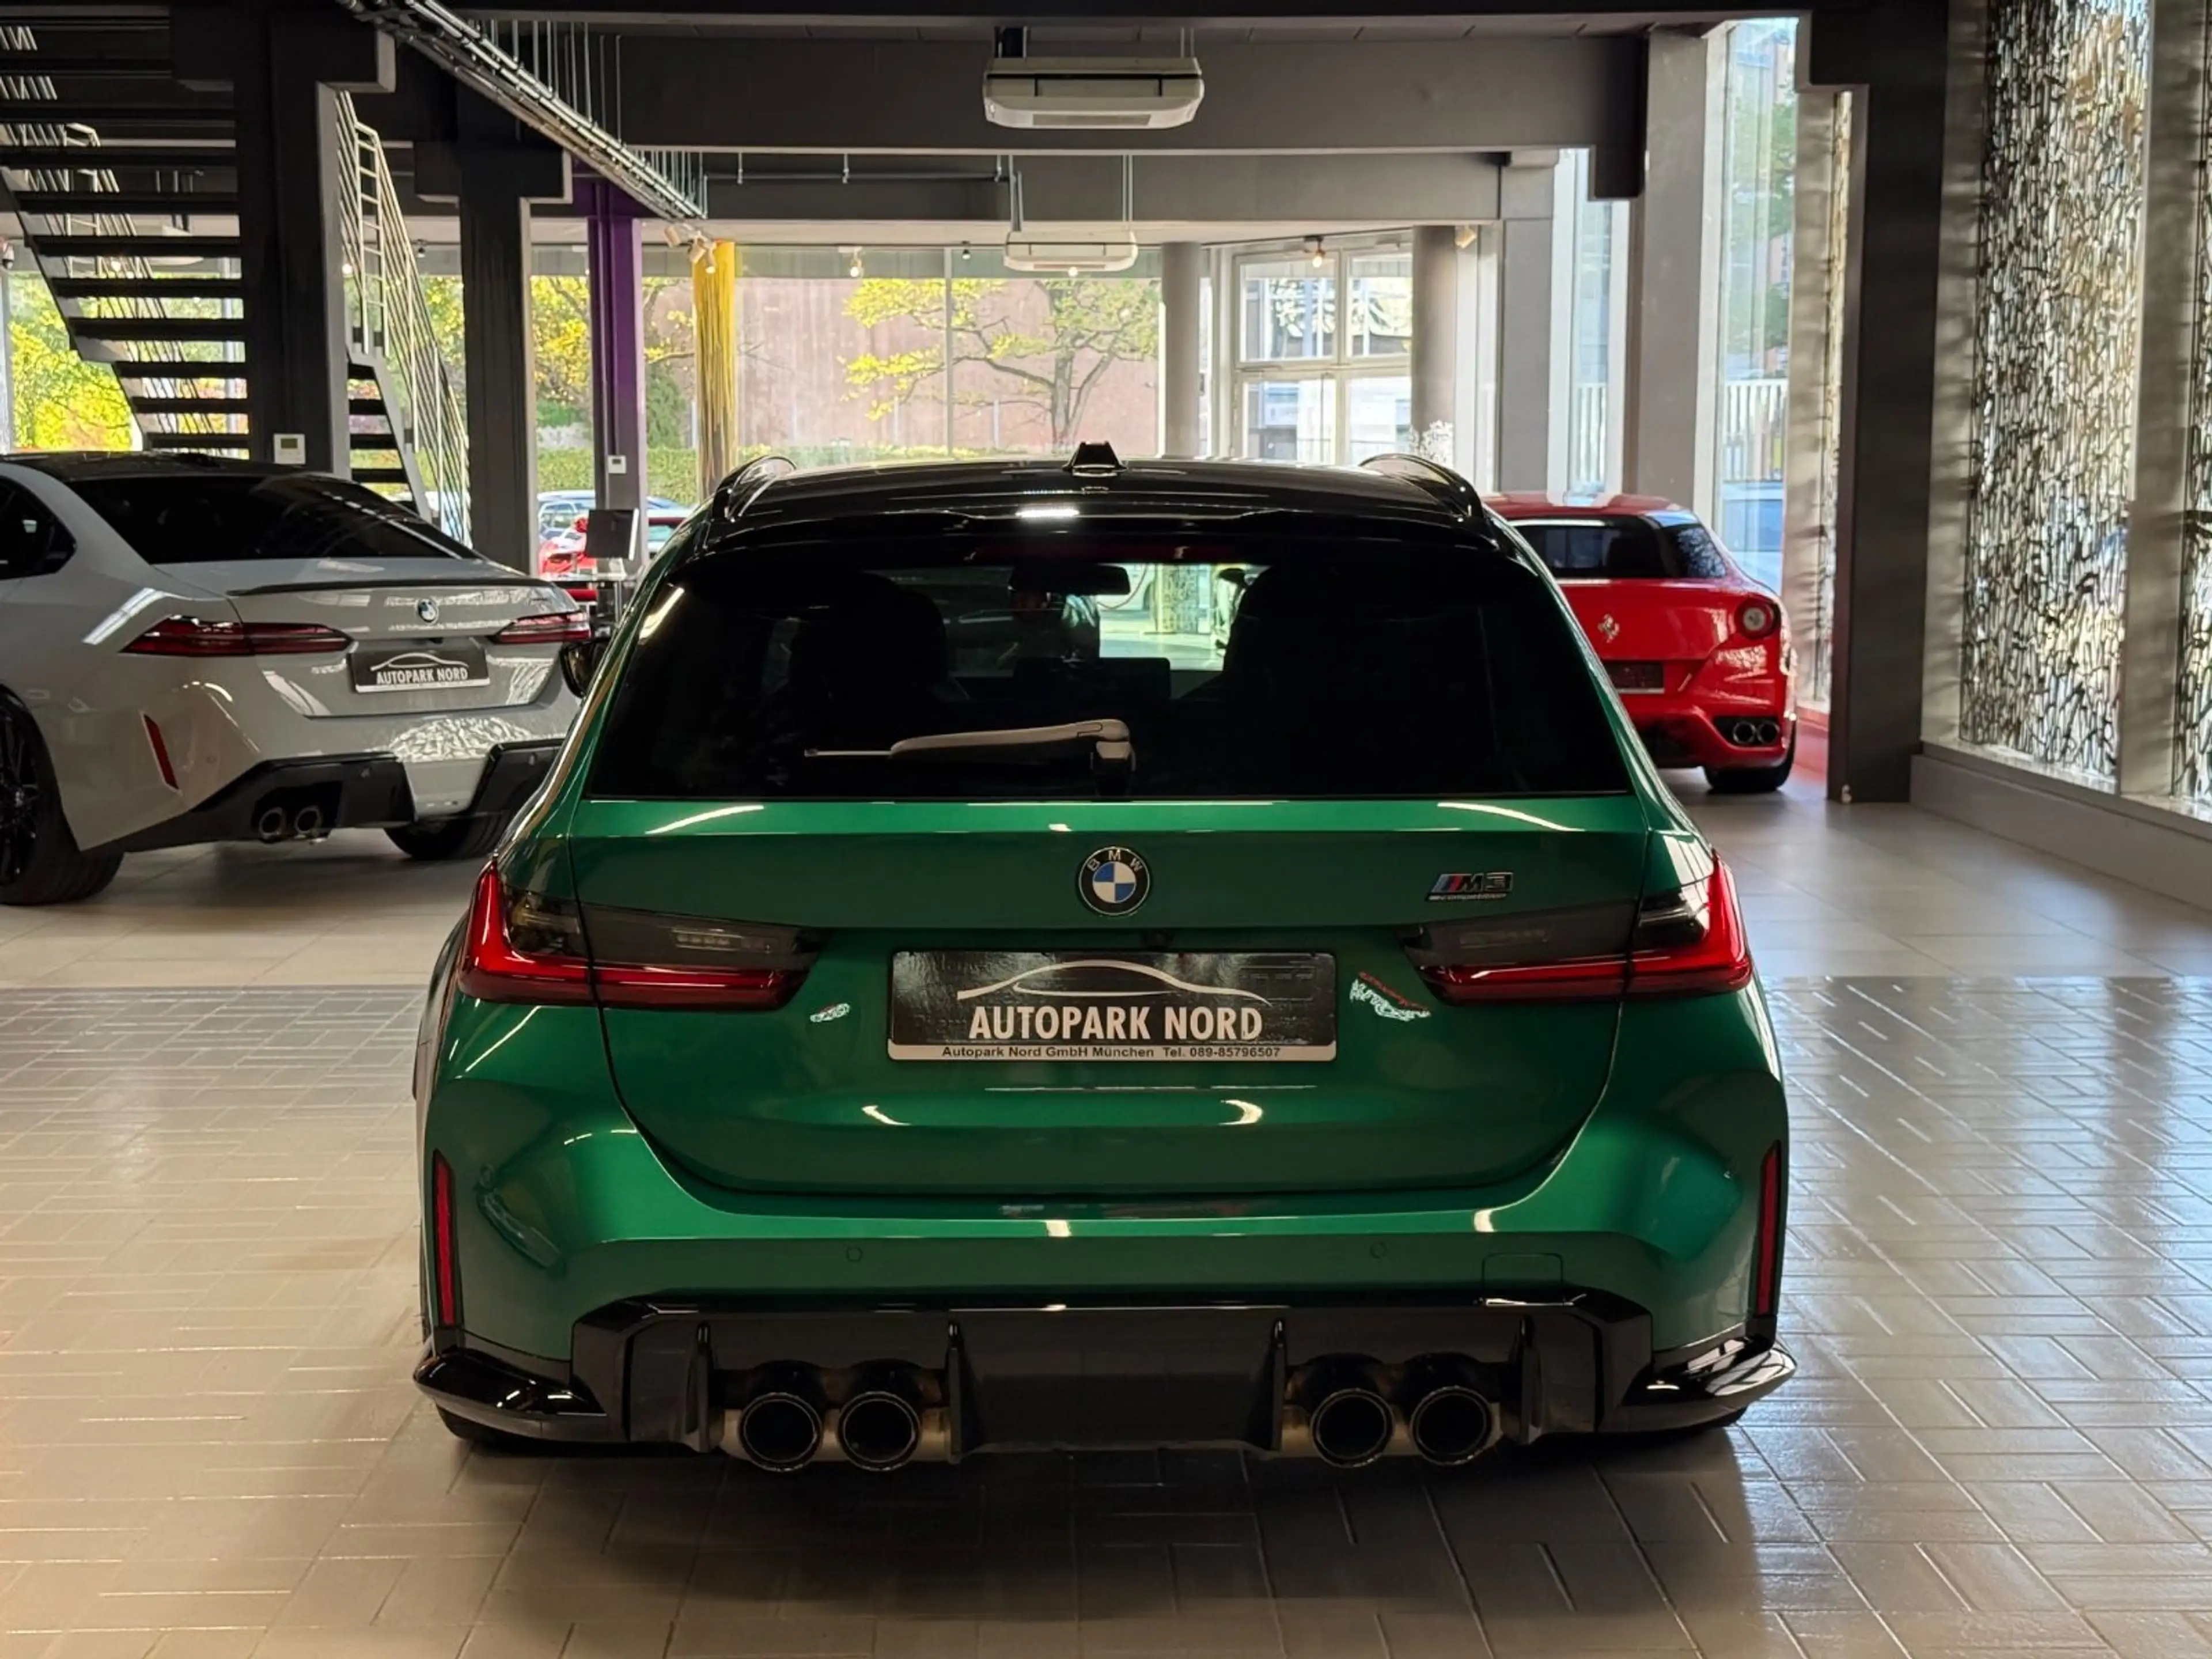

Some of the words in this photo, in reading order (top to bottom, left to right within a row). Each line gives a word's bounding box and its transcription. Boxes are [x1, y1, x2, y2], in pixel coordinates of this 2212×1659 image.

[376, 669, 435, 684] AUTOPARK
[437, 667, 468, 681] NORD
[969, 1006, 1151, 1040] AUTOPARK
[1165, 1006, 1263, 1040] NORD
[942, 1046, 1005, 1058] Autopark
[1009, 1046, 1042, 1057] Nord
[1046, 1046, 1089, 1058] GmbH
[1092, 1046, 1154, 1058] München
[1162, 1046, 1185, 1058] Tel.
[1190, 1046, 1281, 1058] 089-85796507
